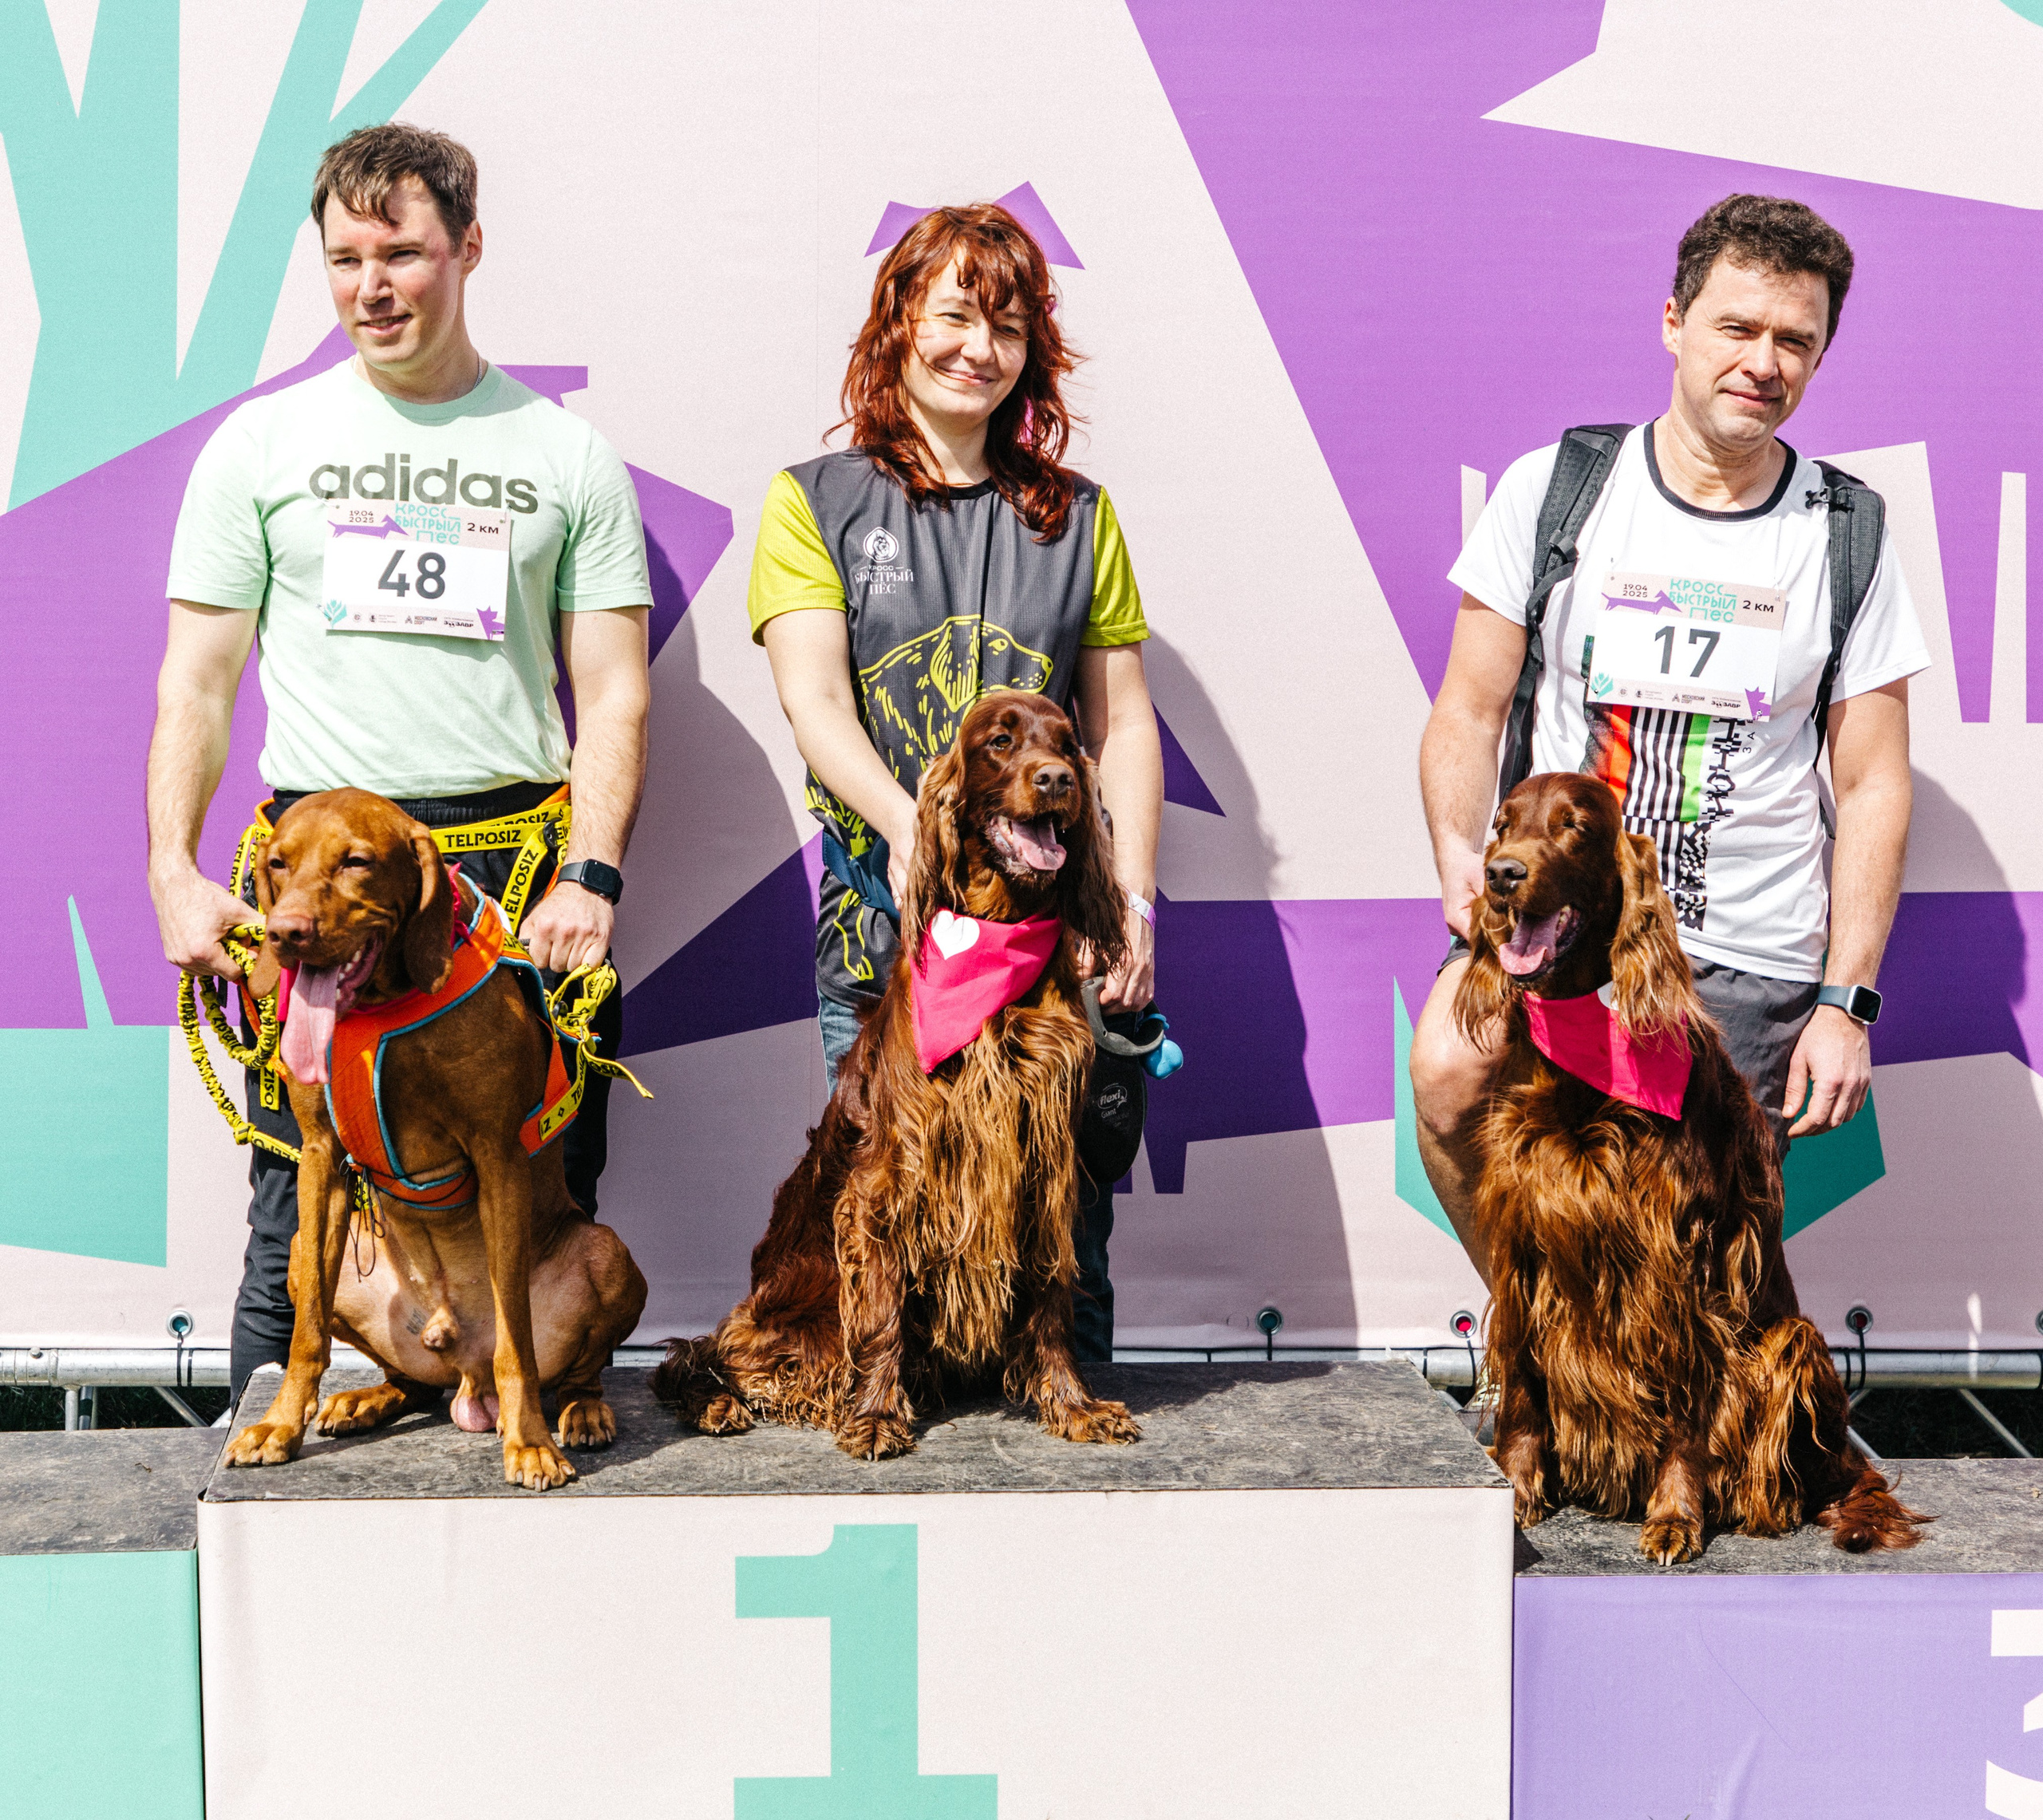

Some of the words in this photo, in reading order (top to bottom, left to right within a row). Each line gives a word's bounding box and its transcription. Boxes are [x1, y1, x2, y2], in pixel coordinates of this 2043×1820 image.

[309, 453, 538, 514] adidas
[467, 523, 475, 531] 2
[377, 549, 446, 599] 48
[870, 582, 896, 594] ПЁС
[1742, 600, 1751, 610] 2
[1654, 626, 1721, 677] 17
[445, 830, 521, 848] TELPOSIZ
[1101, 1089, 1120, 1105] flexi
[733, 1524, 998, 1820] 1
